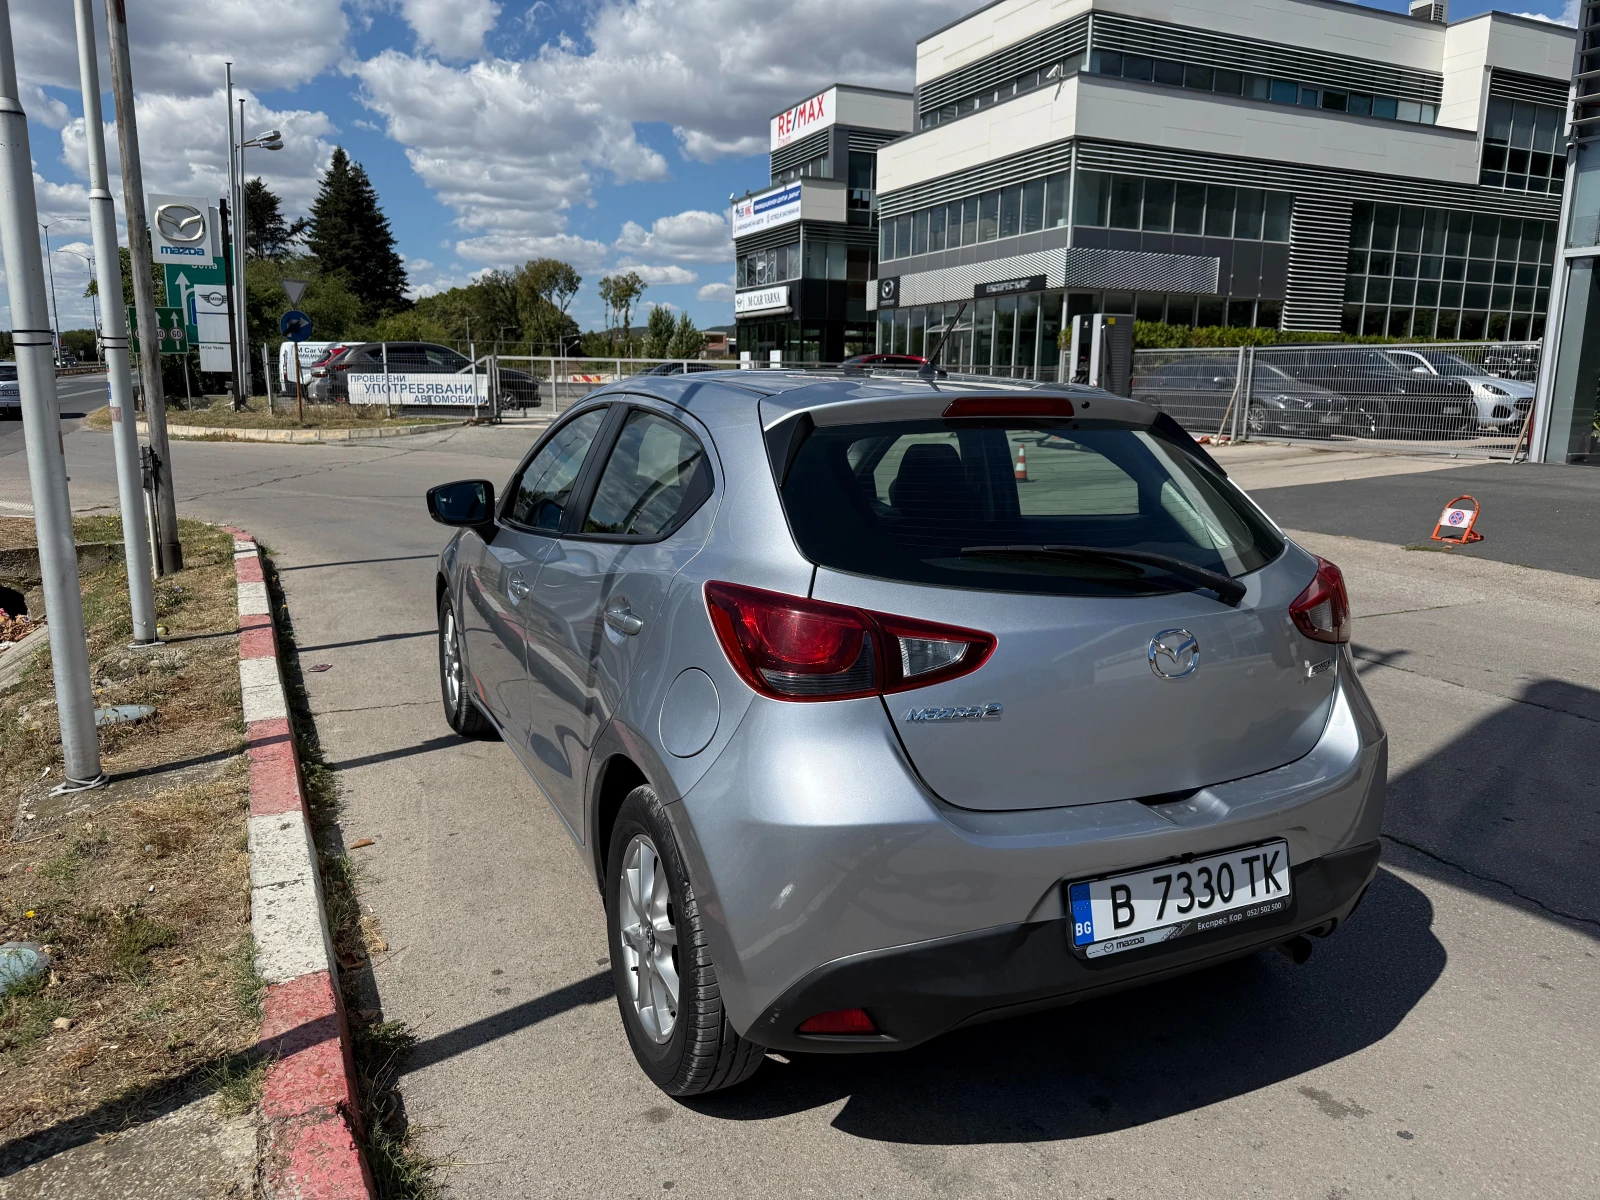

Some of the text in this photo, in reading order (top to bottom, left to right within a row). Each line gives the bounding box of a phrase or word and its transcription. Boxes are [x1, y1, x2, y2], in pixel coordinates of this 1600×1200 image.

[778, 93, 824, 137] RE/MAX
[160, 245, 206, 256] mazda
[171, 330, 182, 338] 60
[364, 383, 473, 395] УПОТРЕБЯВАНИ
[1110, 850, 1283, 930] B 7330 TK
[1246, 902, 1282, 918] 052/ 502 500
[1197, 912, 1243, 931] Експрес Кар
[1075, 922, 1092, 937] BG
[1116, 936, 1145, 950] mazda
